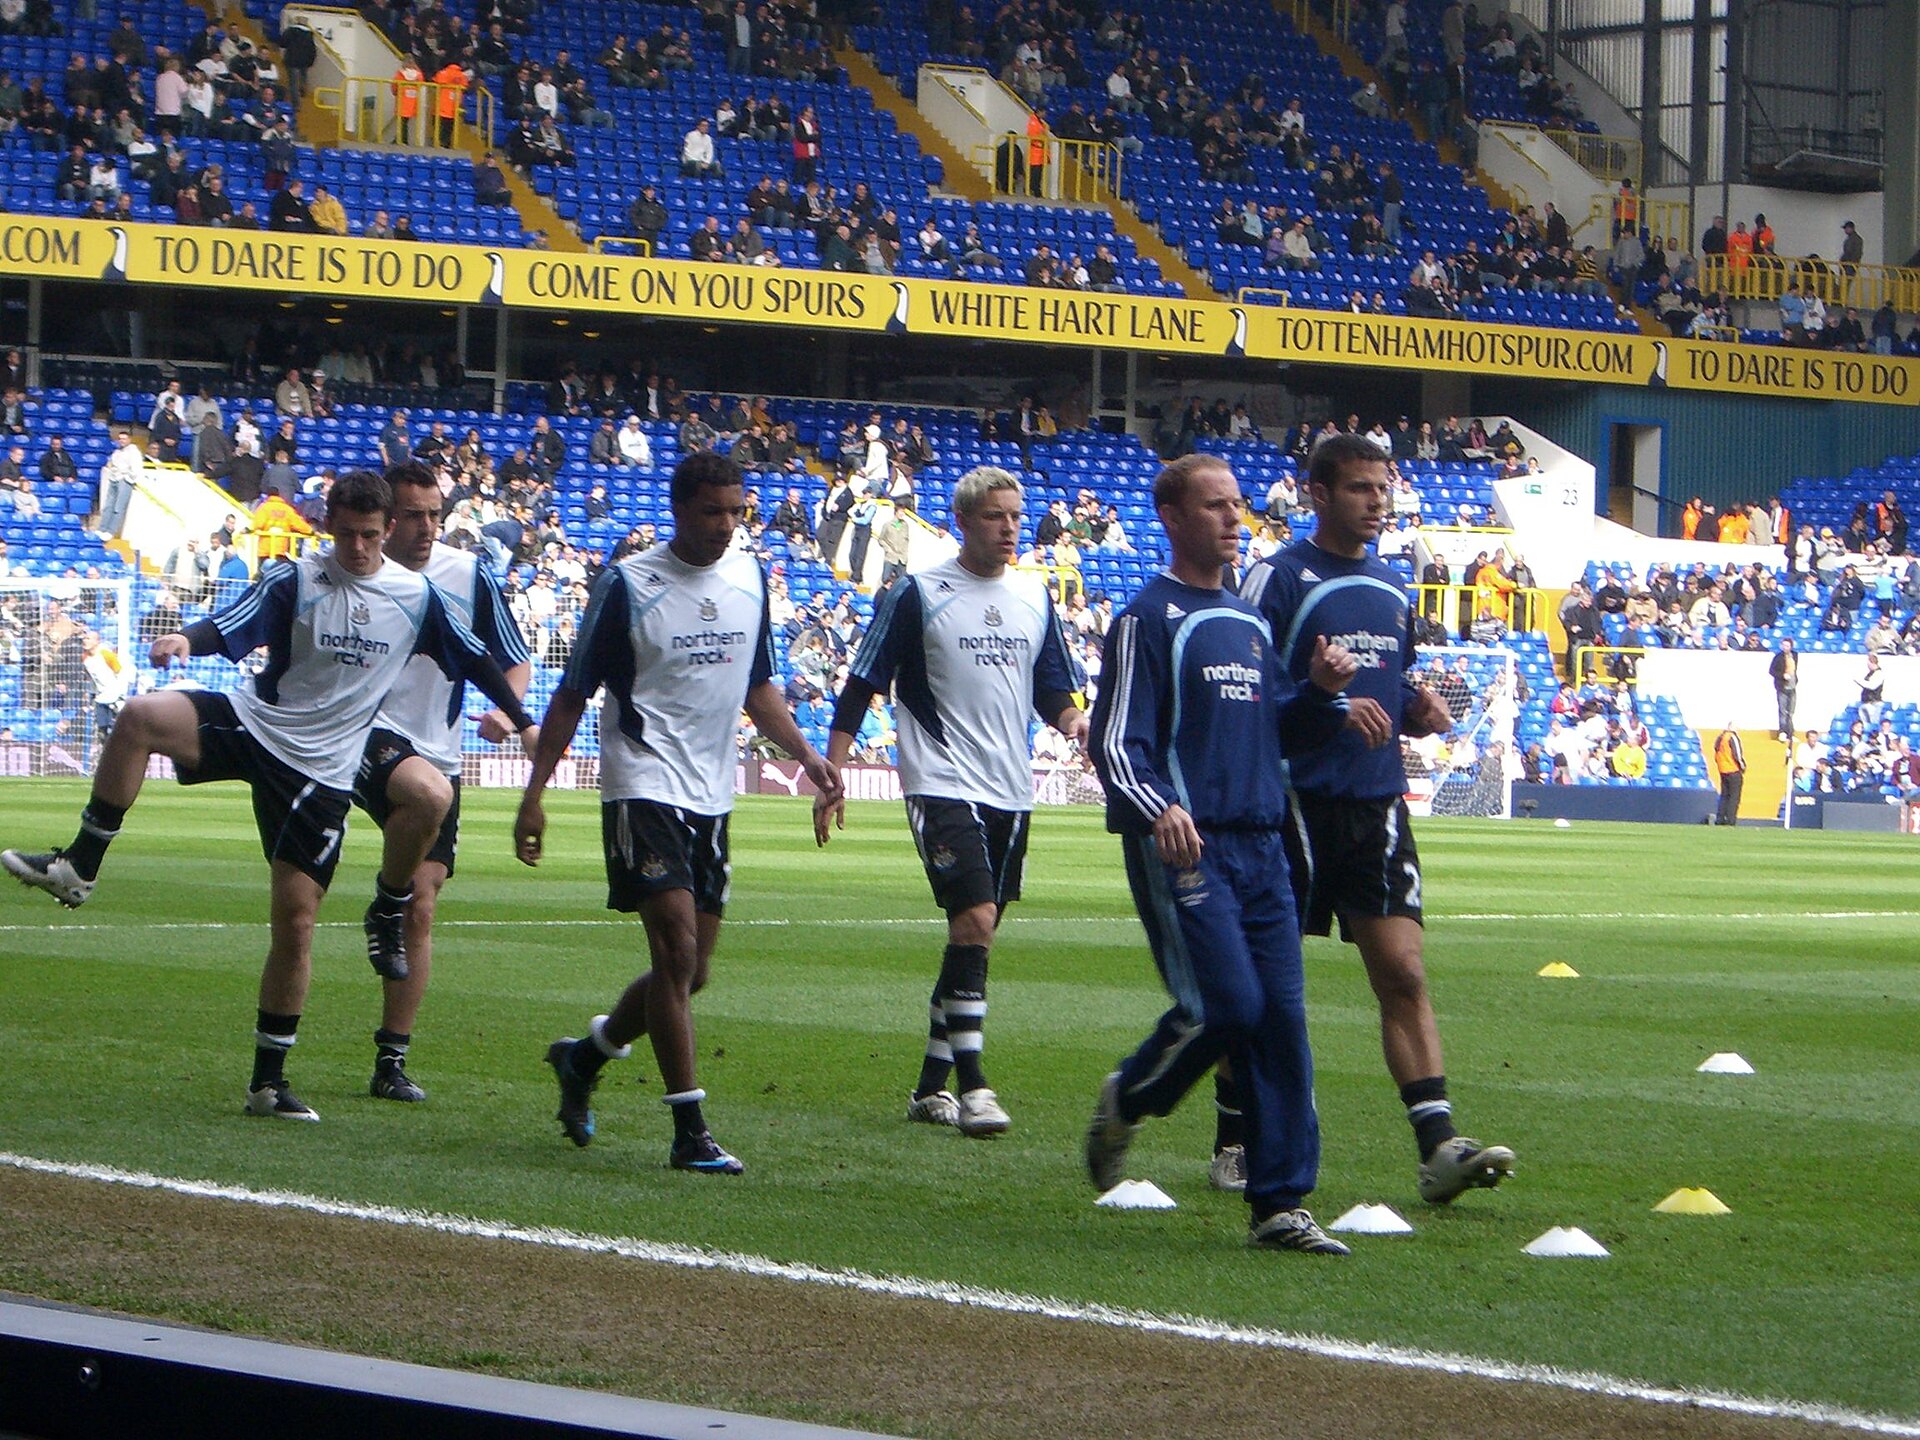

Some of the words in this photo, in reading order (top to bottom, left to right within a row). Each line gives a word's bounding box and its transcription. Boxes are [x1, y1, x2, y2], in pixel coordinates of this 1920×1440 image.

[155, 236, 200, 275] TO
[211, 240, 305, 281] DARE
[318, 246, 347, 283] IS
[357, 249, 402, 288] TO
[412, 253, 463, 291] DO
[528, 265, 621, 302] COME
[631, 268, 678, 308] ON
[688, 272, 753, 312] YOU
[763, 278, 866, 319] SPURS
[930, 290, 1030, 330] WHITE
[1039, 298, 1122, 336] HART
[1130, 305, 1206, 343] LANE
[1277, 317, 1634, 375] TOTTENHAMHOTSPUR.COM
[1686, 348, 1720, 382] TO
[1727, 351, 1796, 389] DARE
[1802, 358, 1826, 391] IS
[1831, 360, 1864, 394] TO
[1871, 363, 1909, 397] DO
[1562, 488, 1579, 506] 23
[671, 629, 748, 650] northern
[959, 633, 1030, 650] northern
[1330, 629, 1399, 652] northern
[1352, 648, 1387, 670] ock.
[313, 827, 340, 866] 7
